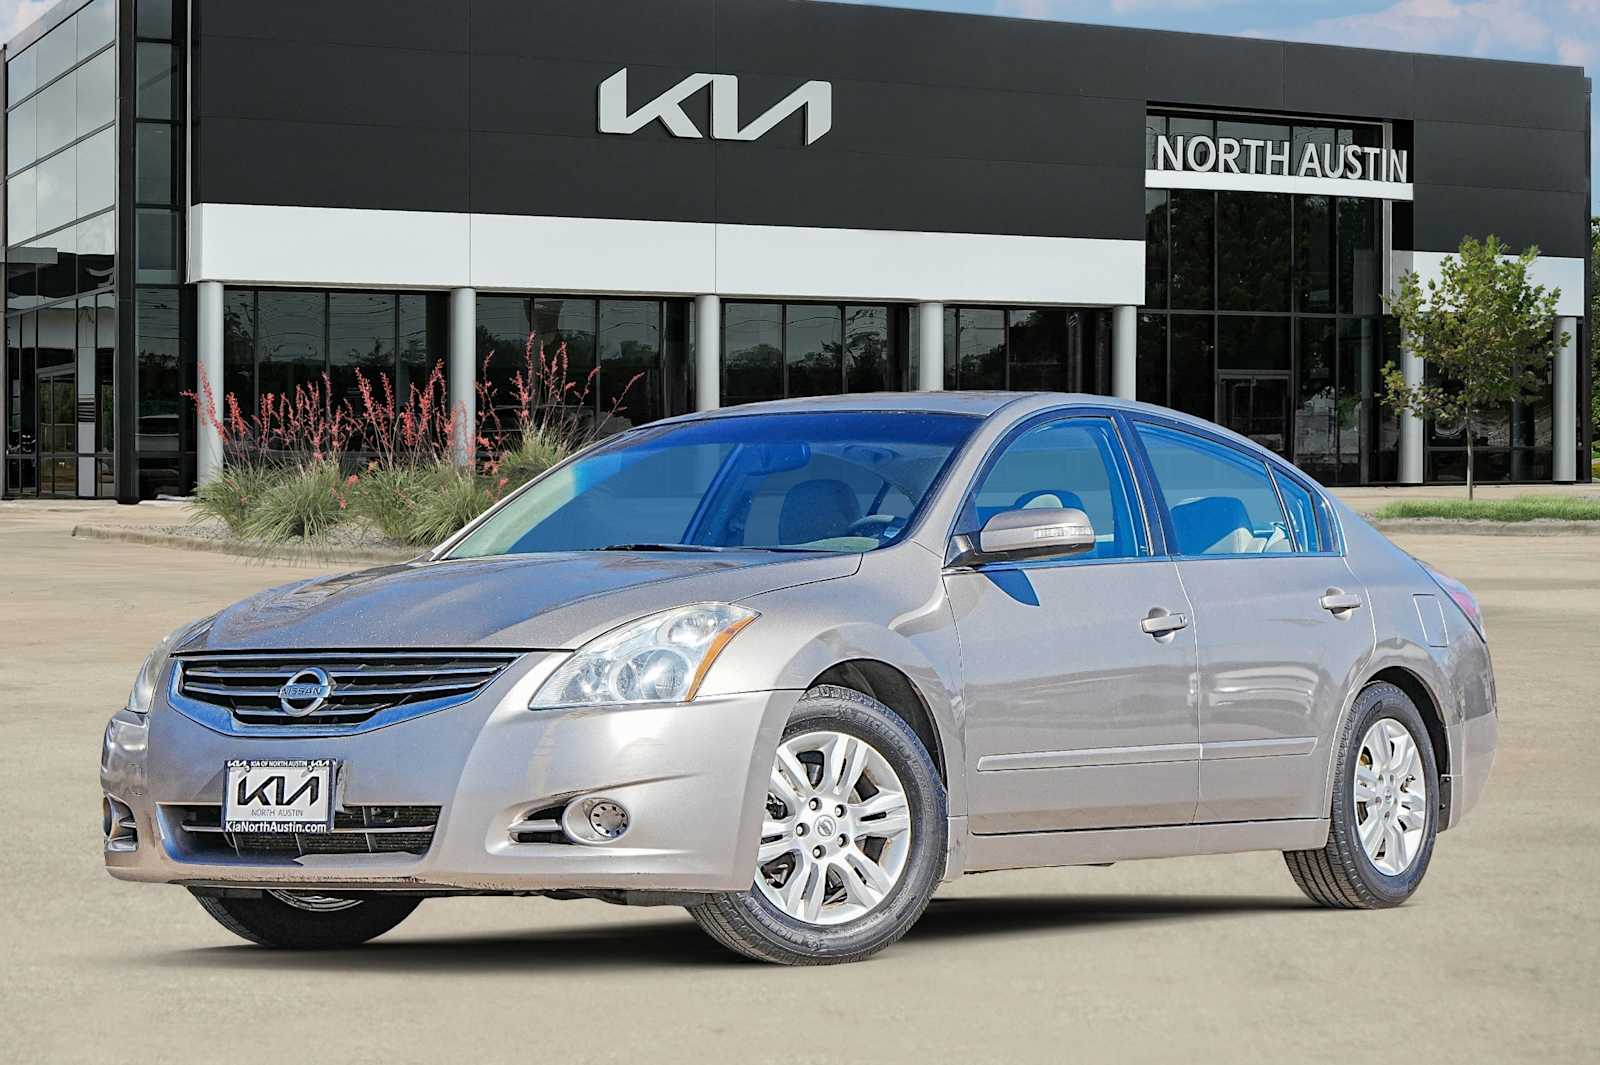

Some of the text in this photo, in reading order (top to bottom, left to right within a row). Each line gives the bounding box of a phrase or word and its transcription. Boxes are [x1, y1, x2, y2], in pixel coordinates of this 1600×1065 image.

[598, 67, 832, 146] KIA
[1157, 135, 1408, 184] NORTH AUSTIN
[281, 687, 321, 697] NISSAN
[237, 776, 320, 806] KIA
[251, 808, 303, 817] NORTH AUSTIN
[225, 821, 327, 833] KiaNorthAustin.com
